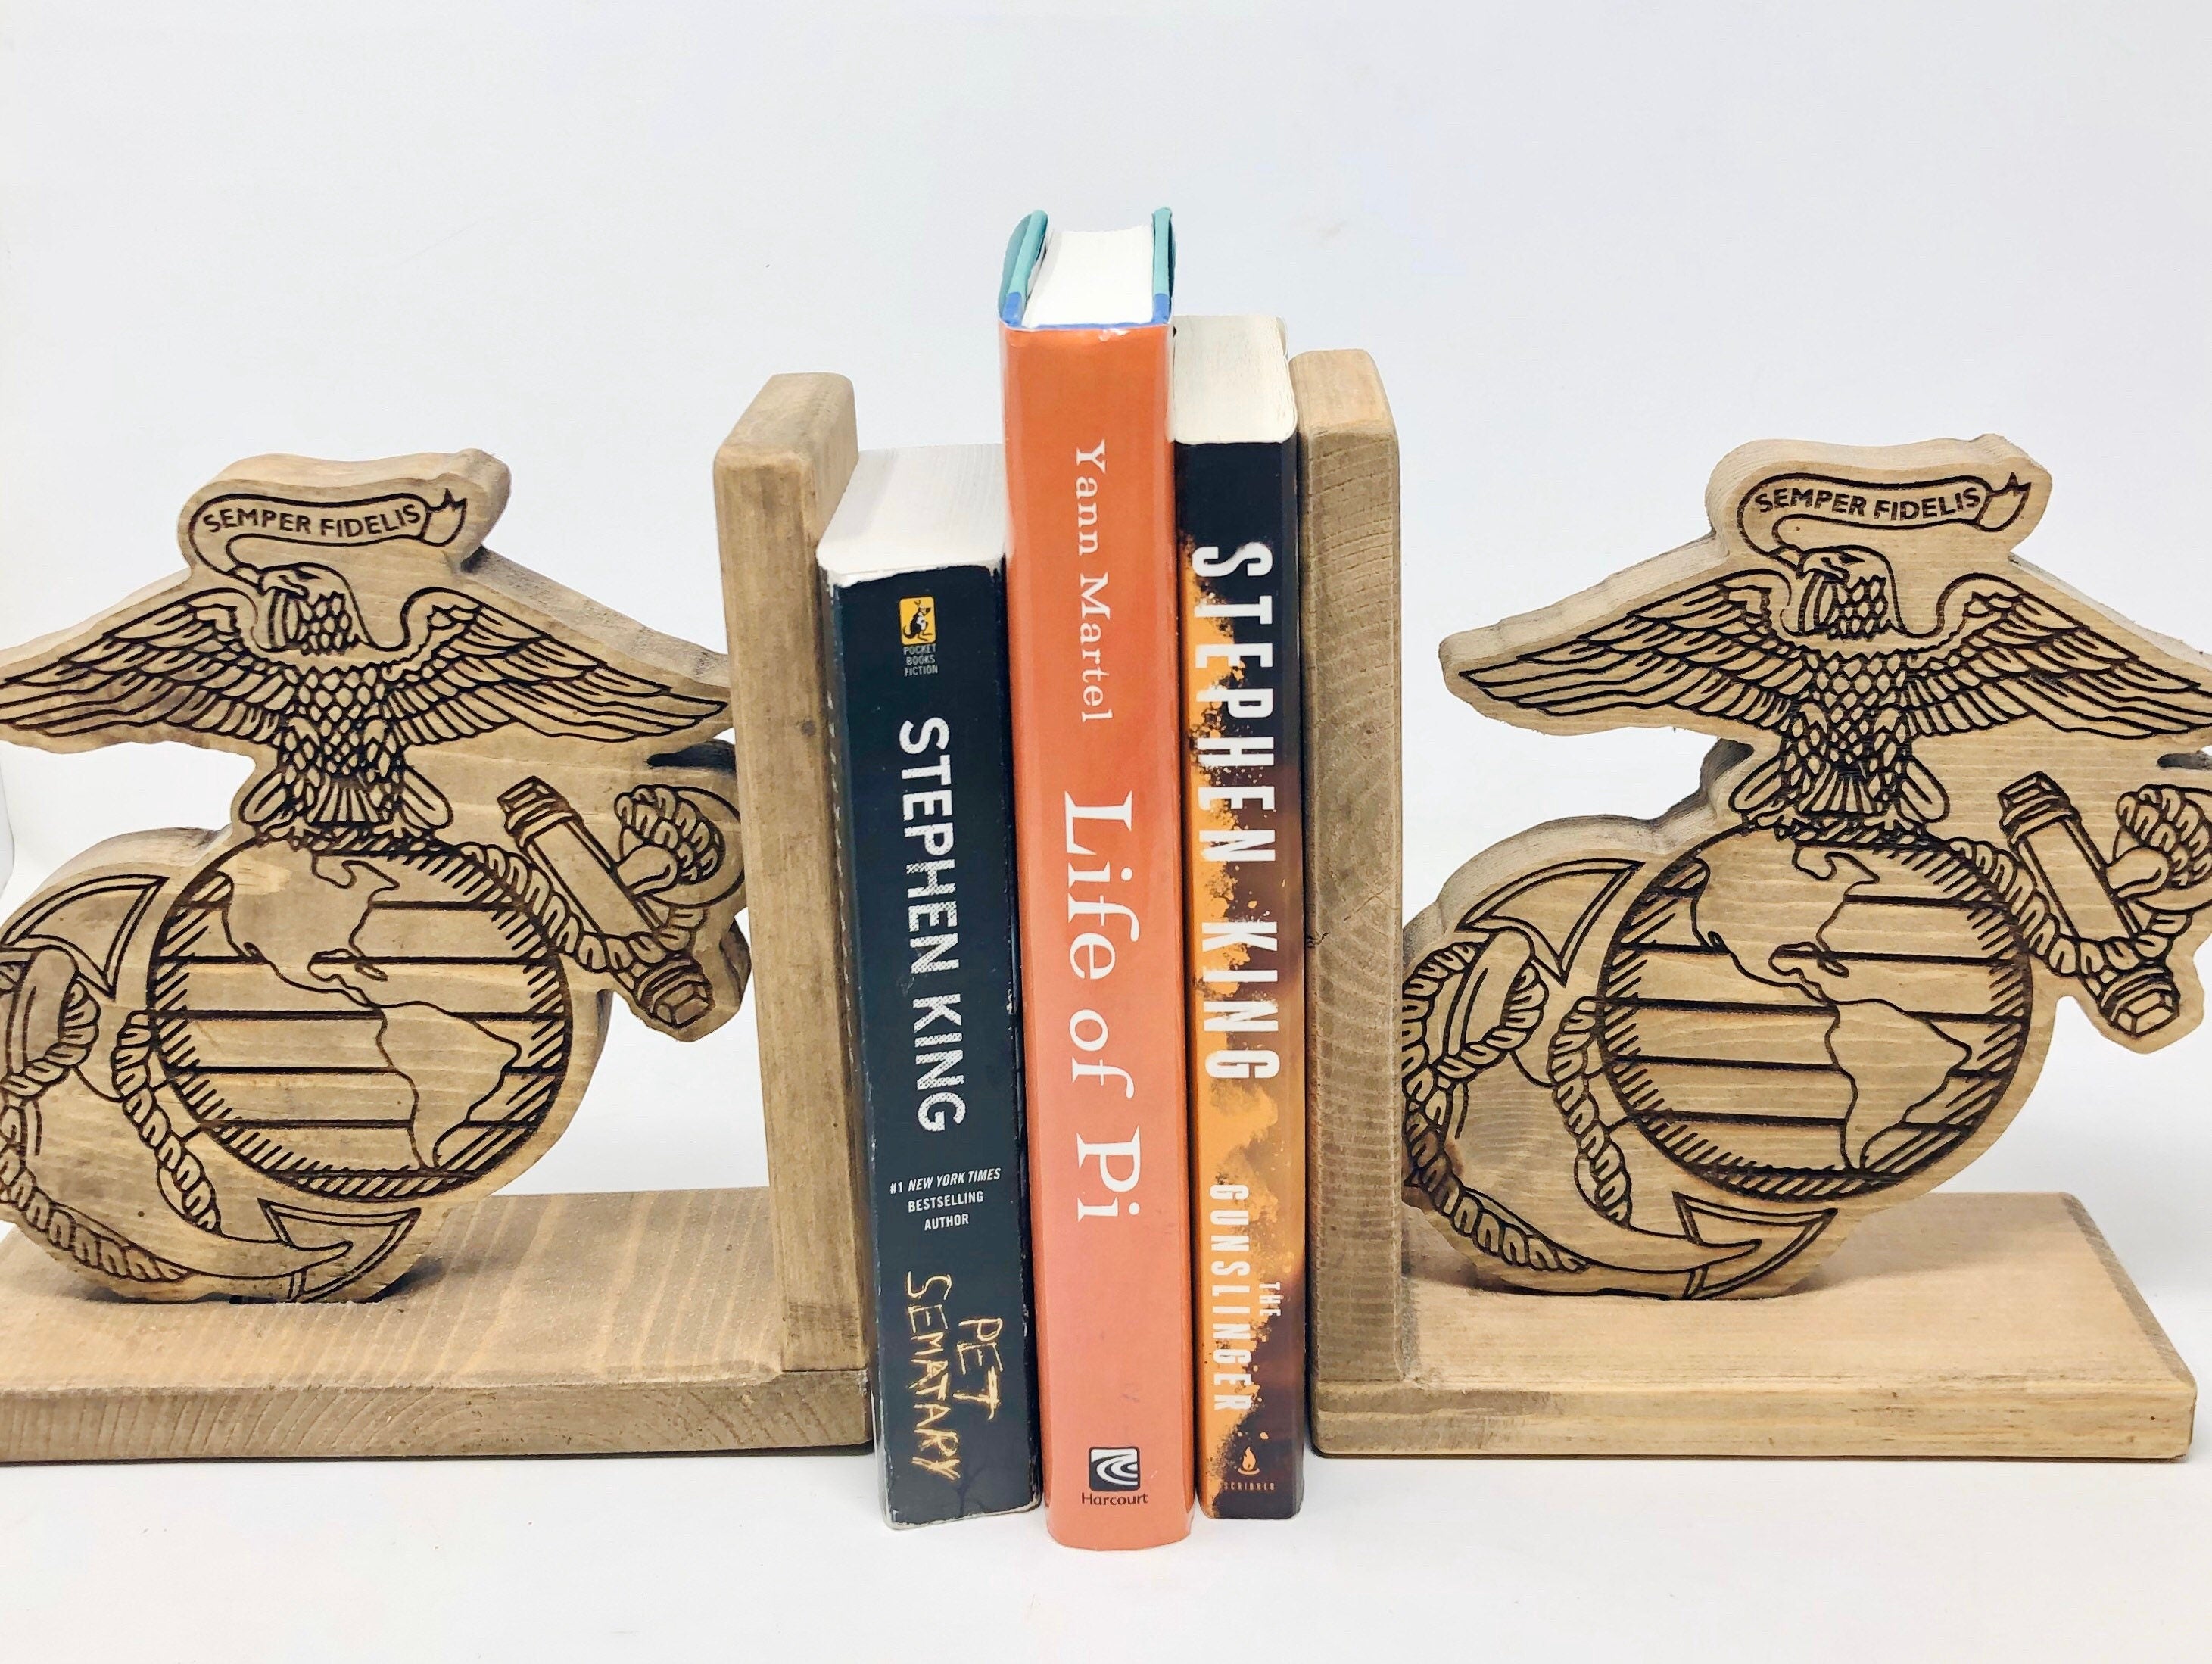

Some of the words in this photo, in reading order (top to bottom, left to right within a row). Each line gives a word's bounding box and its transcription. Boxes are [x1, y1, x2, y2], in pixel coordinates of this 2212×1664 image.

[203, 508, 311, 533] SEMPER
[321, 504, 421, 538] FIDELIS
[1076, 440, 1105, 556] Yann
[1755, 488, 1866, 516] SEMPER
[1873, 487, 1980, 521] FIDELIS
[903, 643, 936, 655] POCKET
[904, 665, 938, 676] FICTION
[906, 655, 936, 665] BOOKS
[1079, 572, 1112, 723] Martel
[1192, 541, 1276, 862] STEPHEN
[899, 716, 960, 974] STEPHEN
[1064, 790, 1141, 981] Life
[1201, 921, 1280, 1079] KING
[912, 993, 967, 1133] KING
[1068, 1009, 1135, 1100] of
[889, 1181, 904, 1195] #1
[908, 1176, 933, 1191] NEW
[936, 1172, 965, 1187] YORK
[967, 1167, 1001, 1183] TIMES
[908, 1191, 984, 1212] BESTSELLING
[1076, 1125, 1142, 1223] Pi
[924, 1213, 969, 1230] AUTHOR
[1209, 1183, 1253, 1412] GUNSLINGER
[1259, 1281, 1282, 1317] THE
[906, 1270, 961, 1481] SEMATARY
[952, 1317, 1004, 1421] PET
[1081, 1491, 1148, 1505] Harcourt
